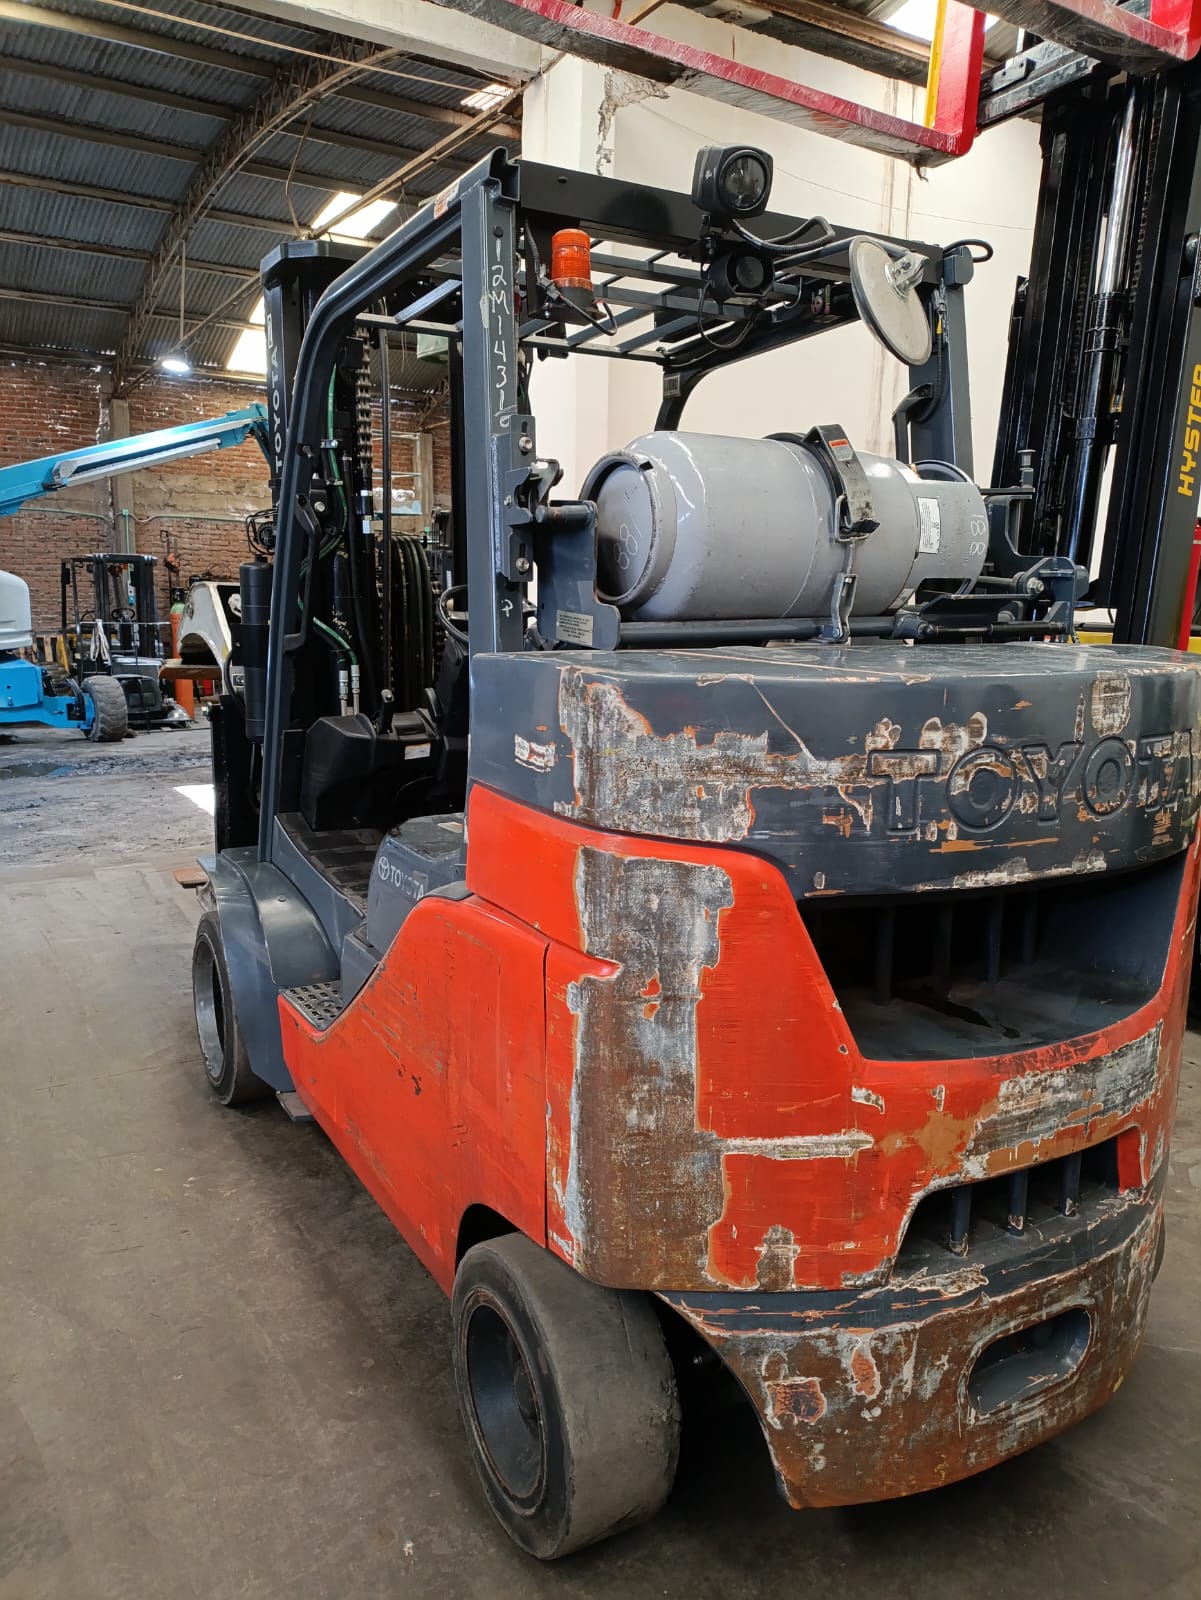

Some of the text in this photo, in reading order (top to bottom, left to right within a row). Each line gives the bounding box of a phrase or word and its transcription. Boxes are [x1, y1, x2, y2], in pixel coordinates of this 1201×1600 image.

[271, 344, 283, 474] TOYOTA
[866, 727, 1193, 836] TOYOTA
[390, 864, 425, 901] TOYOTA
